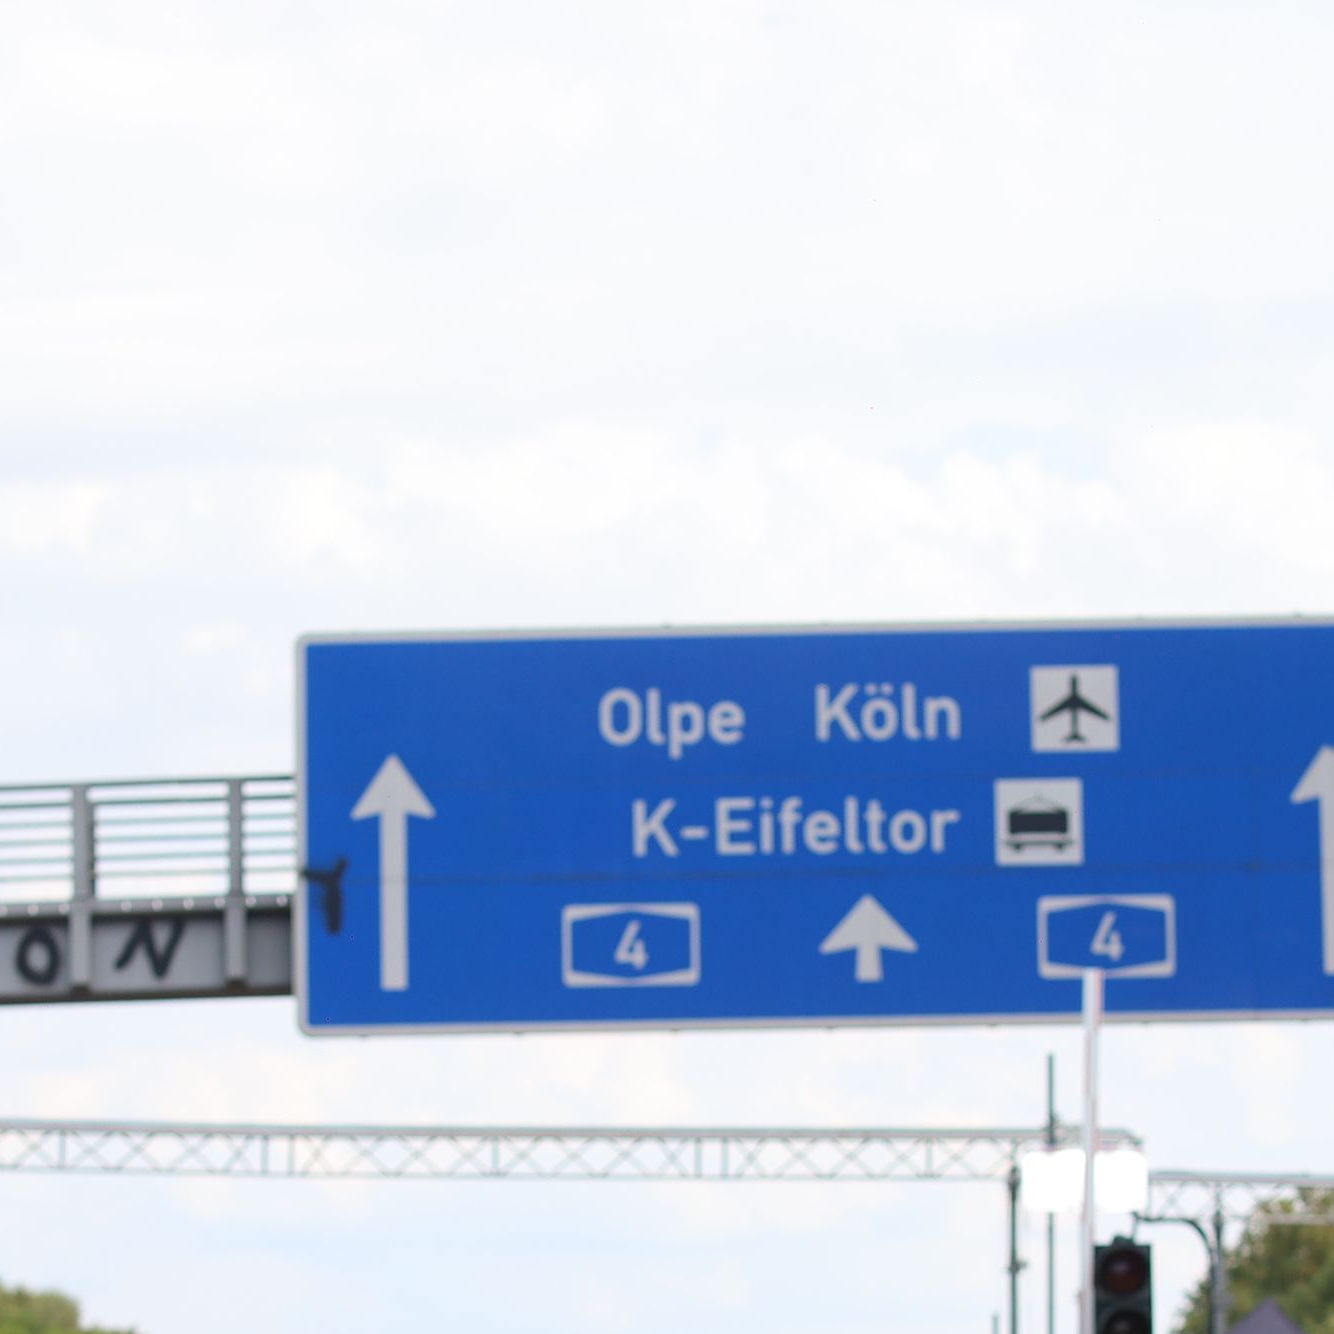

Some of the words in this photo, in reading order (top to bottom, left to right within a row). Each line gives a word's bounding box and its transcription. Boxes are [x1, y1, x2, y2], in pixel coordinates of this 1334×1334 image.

[598, 687, 746, 758] Olpe
[815, 683, 962, 742] Köln
[632, 796, 960, 858] K-Eifeltor
[614, 919, 649, 970] 4
[1090, 911, 1124, 963] 4
